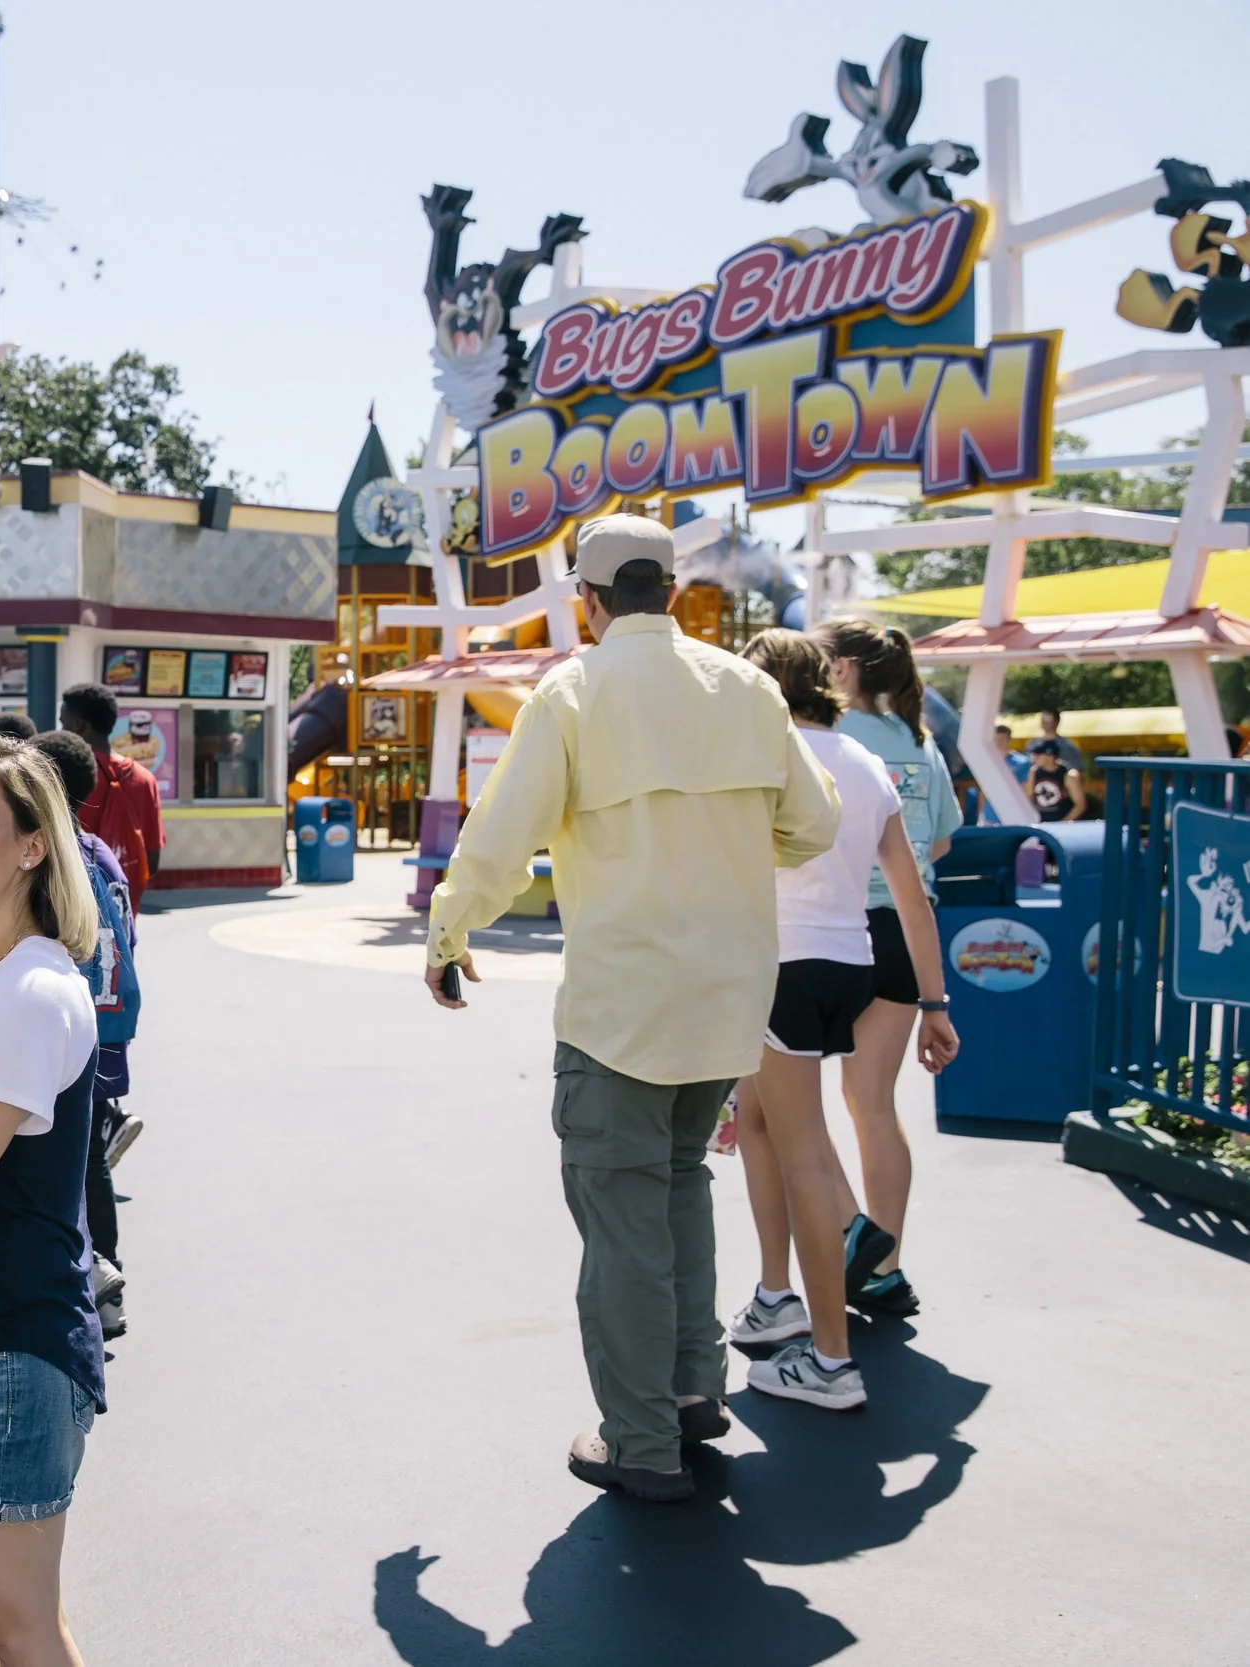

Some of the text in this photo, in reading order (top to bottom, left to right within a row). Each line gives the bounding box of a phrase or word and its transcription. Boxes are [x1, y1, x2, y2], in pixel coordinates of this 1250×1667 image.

[535, 210, 962, 393] Bugs Bunny
[778, 1364, 805, 1387] N
